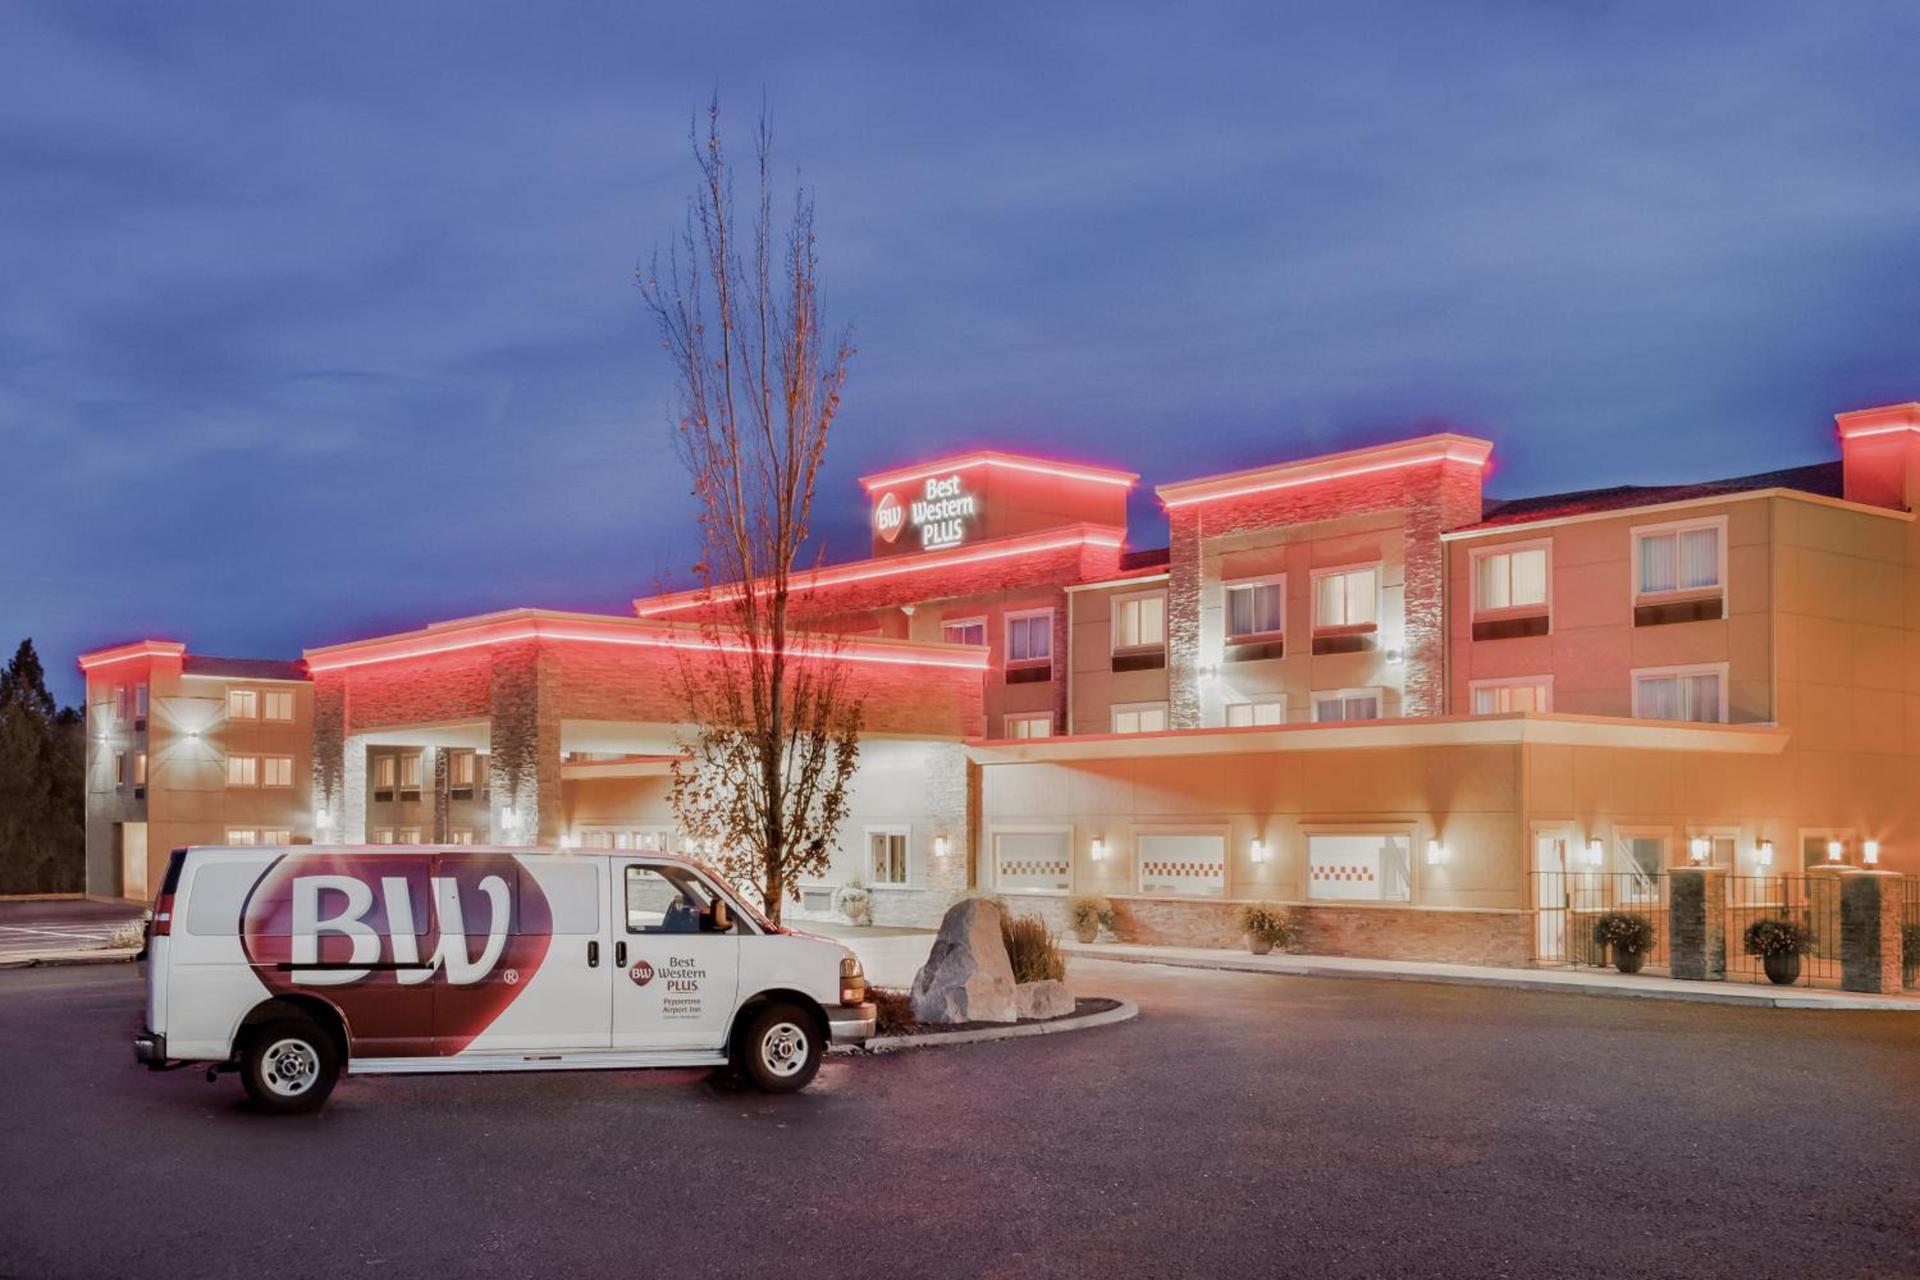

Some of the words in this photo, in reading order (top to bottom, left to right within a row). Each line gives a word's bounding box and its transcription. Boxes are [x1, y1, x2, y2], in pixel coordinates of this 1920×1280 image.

[925, 475, 960, 499] Best
[879, 506, 901, 530] BW
[912, 496, 974, 523] Western
[923, 519, 962, 545] PLUS
[291, 875, 511, 985] BW
[632, 968, 653, 979] BW
[658, 968, 706, 979] Western
[669, 957, 696, 968] Best
[667, 980, 698, 991] PLUS
